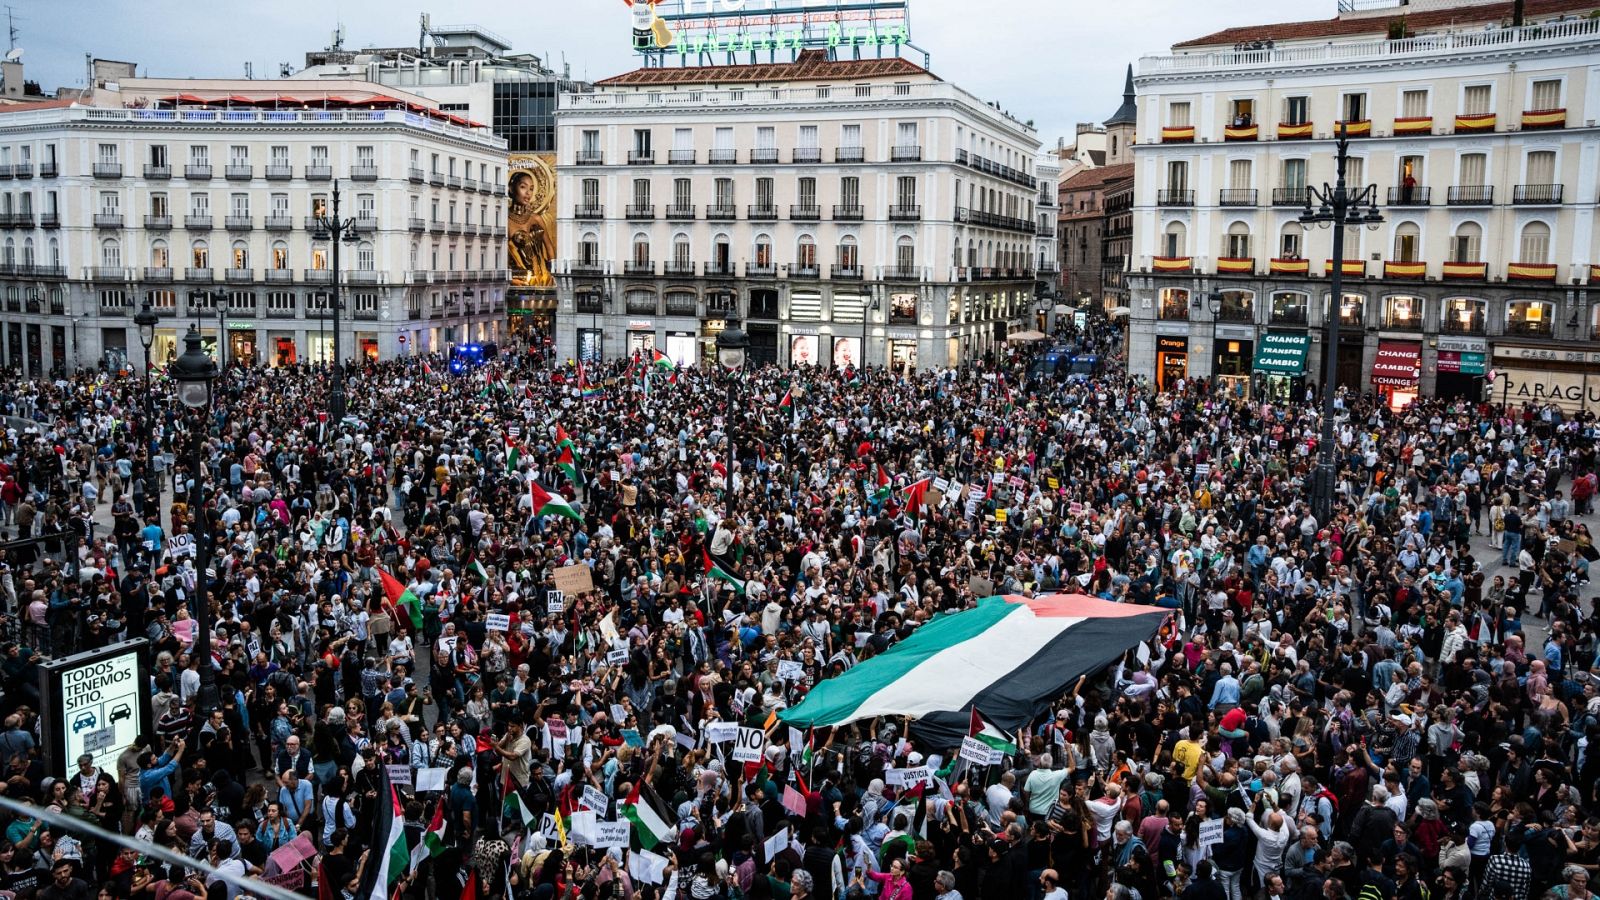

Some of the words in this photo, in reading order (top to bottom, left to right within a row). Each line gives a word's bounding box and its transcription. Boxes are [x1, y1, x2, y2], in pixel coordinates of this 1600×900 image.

[791, 327, 818, 335] SEPHORA
[1160, 339, 1185, 348] Orange
[1265, 335, 1306, 344] CHANGE
[1262, 347, 1302, 356] TRANSFER
[1470, 343, 1485, 352] SOL
[1378, 350, 1419, 359] CHANGE
[1521, 349, 1557, 361] CASA
[1565, 352, 1585, 362] DE
[1259, 358, 1299, 367] CAMBIO
[1374, 363, 1415, 372] CAMBIO
[1377, 377, 1411, 386] CHANGE
[169, 535, 187, 549] NO
[549, 592, 562, 603] PAZ
[64, 661, 113, 684] TODOS
[65, 668, 131, 697] TENEMOS
[66, 690, 104, 710] SITIO.
[736, 727, 763, 749] NO
[904, 769, 928, 780] JUSTICIA
